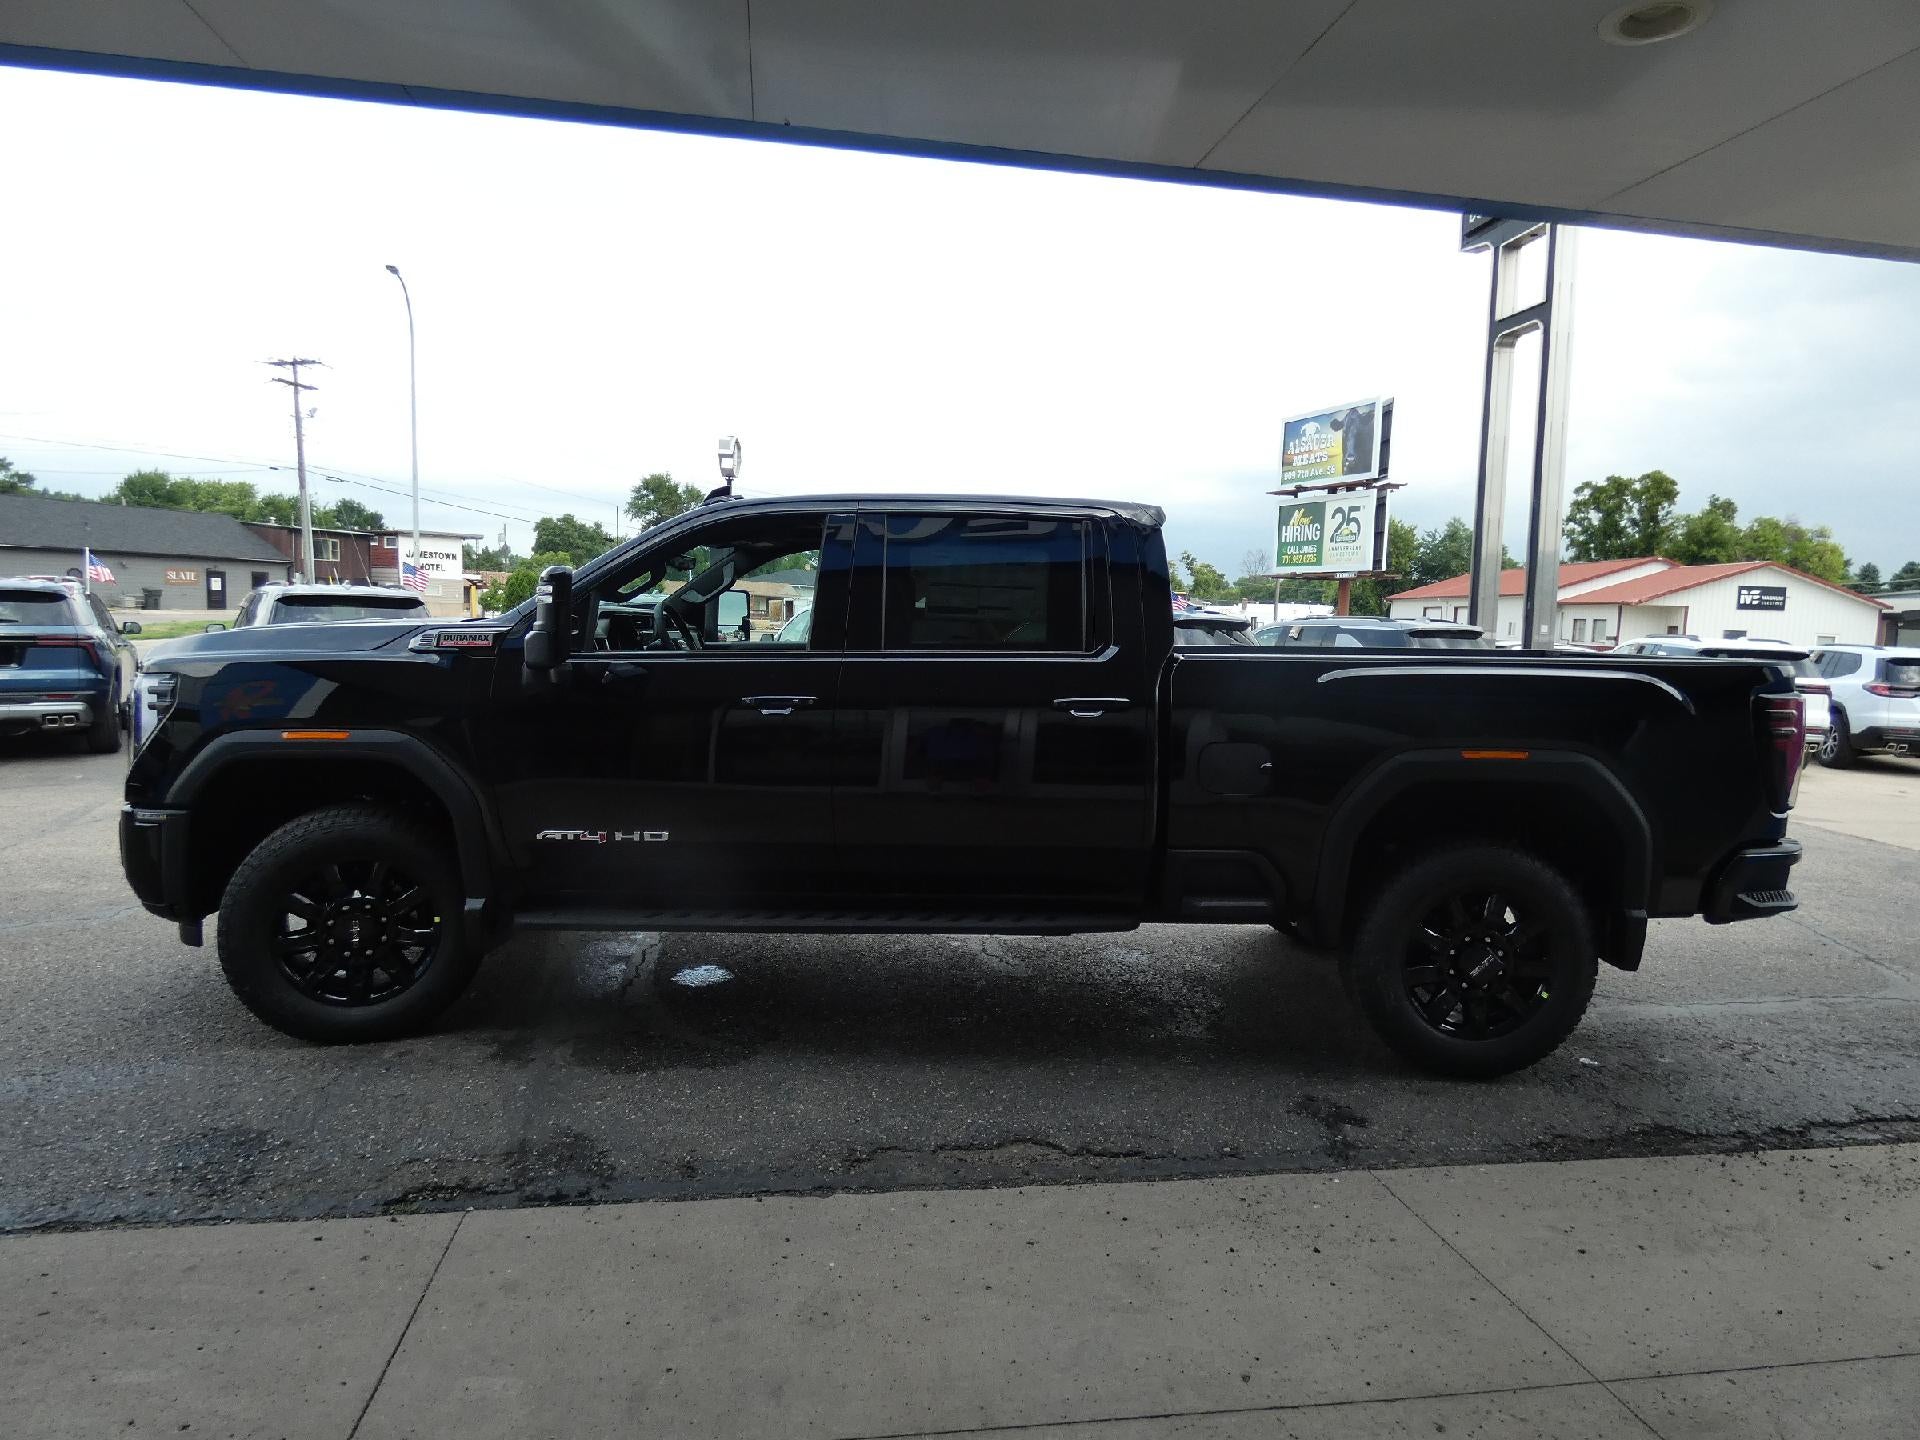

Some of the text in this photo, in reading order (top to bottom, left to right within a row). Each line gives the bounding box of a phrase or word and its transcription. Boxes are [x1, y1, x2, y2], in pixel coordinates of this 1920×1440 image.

[1293, 452, 1328, 467] MEATS
[1330, 506, 1361, 543] 25
[1281, 523, 1320, 542] HIRING
[1287, 544, 1317, 554] CALL JAMES
[166, 571, 197, 580] SLATE
[536, 830, 669, 843] AT4 HD
